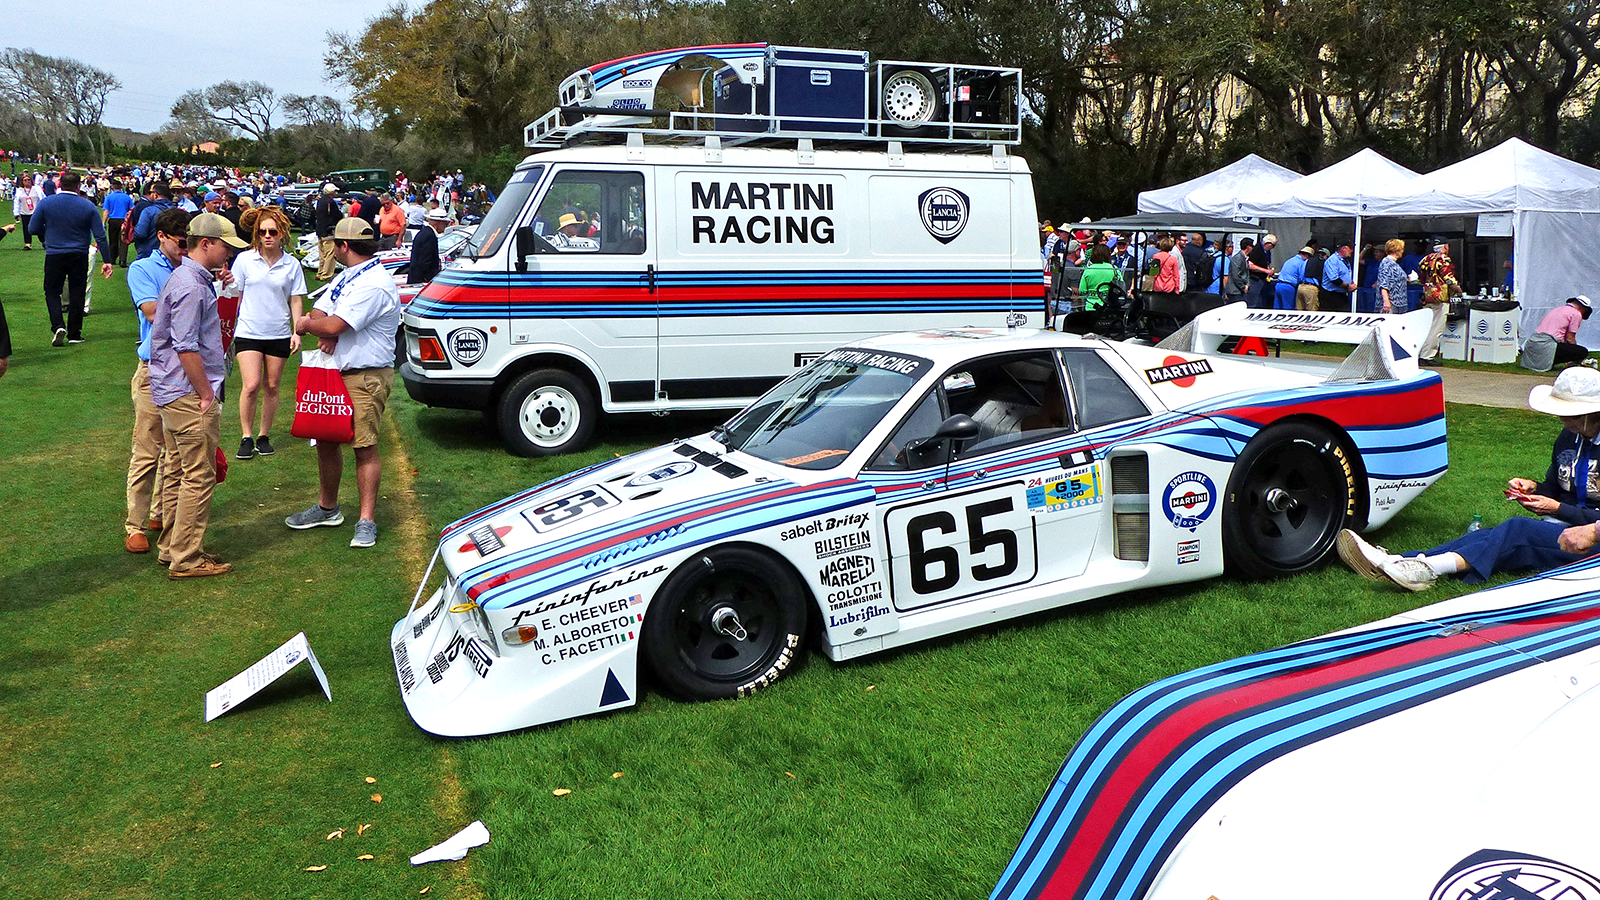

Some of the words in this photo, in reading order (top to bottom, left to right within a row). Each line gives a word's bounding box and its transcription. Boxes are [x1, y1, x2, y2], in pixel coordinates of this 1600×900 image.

[692, 182, 833, 211] MARTINI
[933, 208, 958, 217] LANCIA
[693, 216, 835, 244] RACING
[1246, 313, 1326, 324] MARTINI
[823, 350, 868, 367] MARTINI
[867, 354, 919, 374] RACING
[1150, 360, 1211, 383] MARTINI
[302, 390, 346, 404] duPont
[1028, 477, 1042, 488] 24
[1045, 473, 1064, 484] HEURES
[1073, 467, 1089, 475] MANS
[1170, 473, 1207, 488] SPORTLINE
[1333, 446, 1355, 516] PIRELLI
[1374, 480, 1427, 493] pininfarina
[533, 489, 609, 526] 65
[1173, 493, 1207, 507] MARTINI
[780, 520, 823, 541] sabelt
[825, 512, 870, 531] Britax
[814, 530, 871, 554] BILSTEIN
[907, 496, 1018, 594] 65
[820, 567, 875, 587] MARELLI
[511, 565, 668, 627] pininfarina
[827, 581, 882, 603] COLOTTI
[829, 592, 882, 611] TRANSMISIONE
[542, 618, 556, 631] E.
[559, 599, 629, 626] CHEEVER
[829, 605, 890, 628] Lubrifilm
[534, 640, 550, 651] M.
[554, 616, 629, 646] ALBORETO
[463, 637, 493, 679] PIRELLI
[541, 653, 556, 665] C.
[559, 634, 620, 660] FACETTI
[737, 633, 799, 698] PIRELLI
[399, 666, 415, 693] LANCIA
